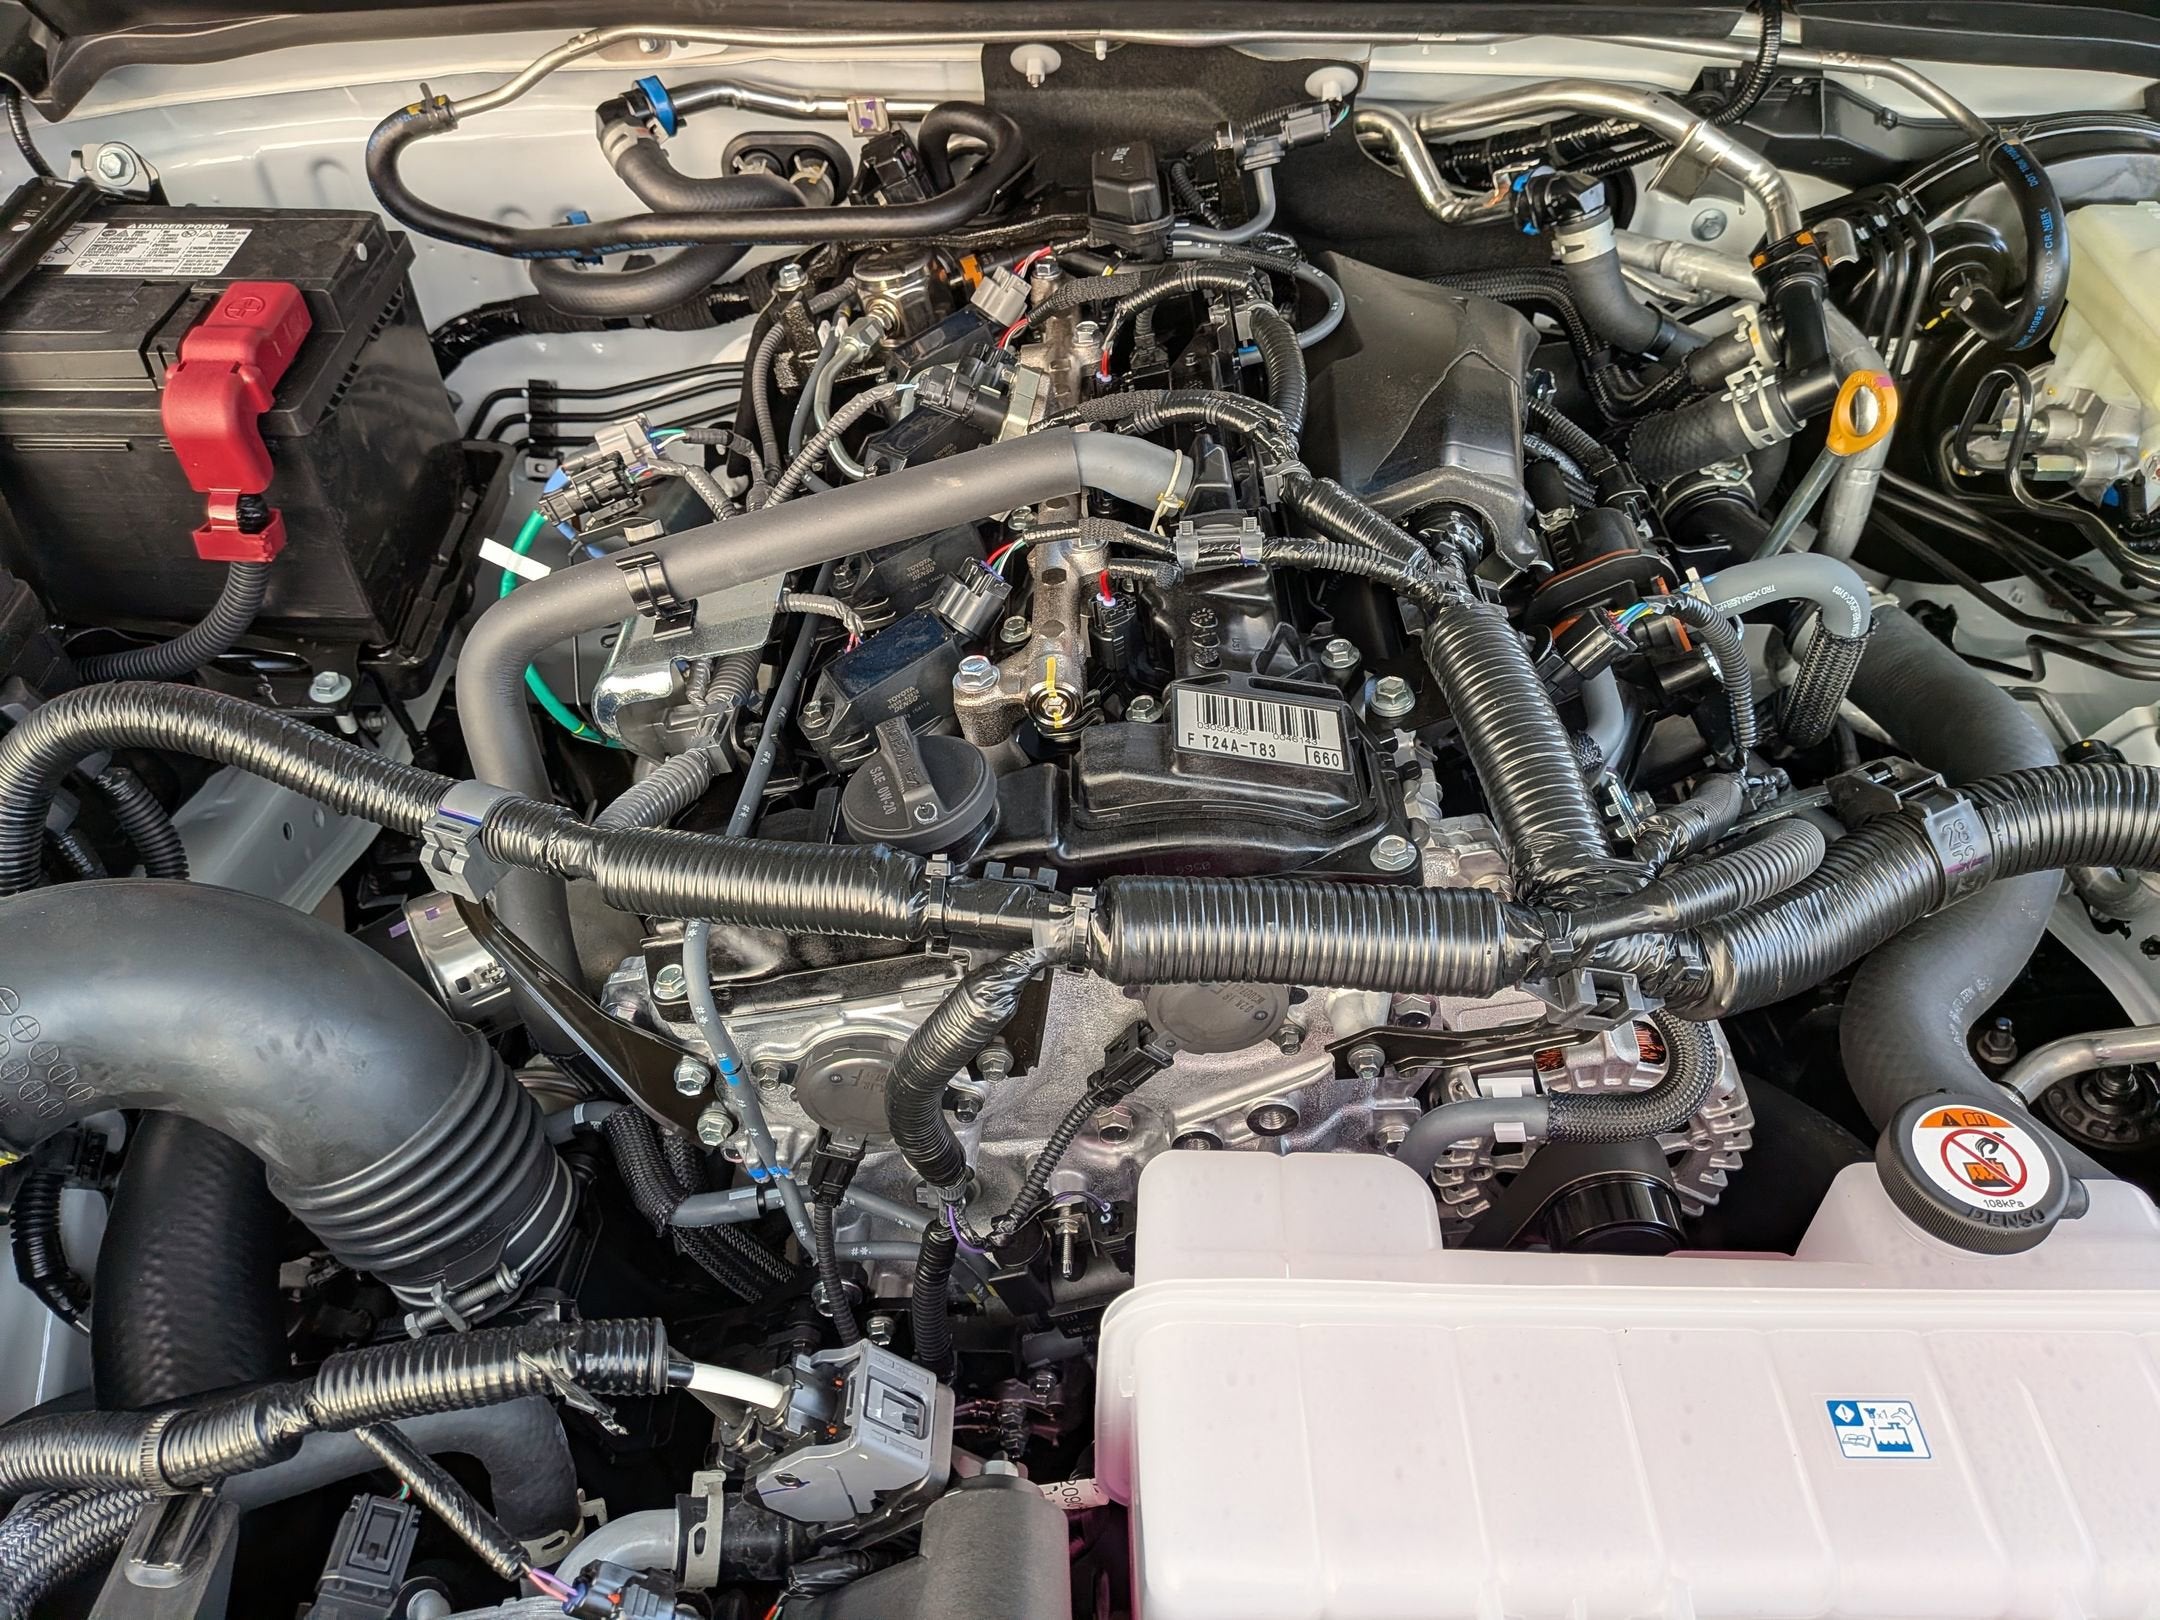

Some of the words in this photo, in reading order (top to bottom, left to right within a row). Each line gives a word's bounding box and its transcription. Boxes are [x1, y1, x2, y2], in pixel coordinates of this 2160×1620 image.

[906, 557, 933, 573] TOYOTA
[912, 566, 935, 581] DENSO
[887, 686, 916, 704] TOYOTA
[894, 695, 918, 713] DENSO
[1197, 721, 1250, 736] 03050232
[1272, 732, 1319, 746] 0046143
[1187, 732, 1195, 746] F
[1203, 734, 1277, 759] T24A-T83
[1313, 750, 1340, 767] 660
[869, 766, 886, 785] SAE
[877, 785, 897, 816] 0W-20
[1941, 818, 1970, 851] 28
[1984, 1199, 2025, 1208] 108kPa
[1967, 1207, 2046, 1229] DENSO
